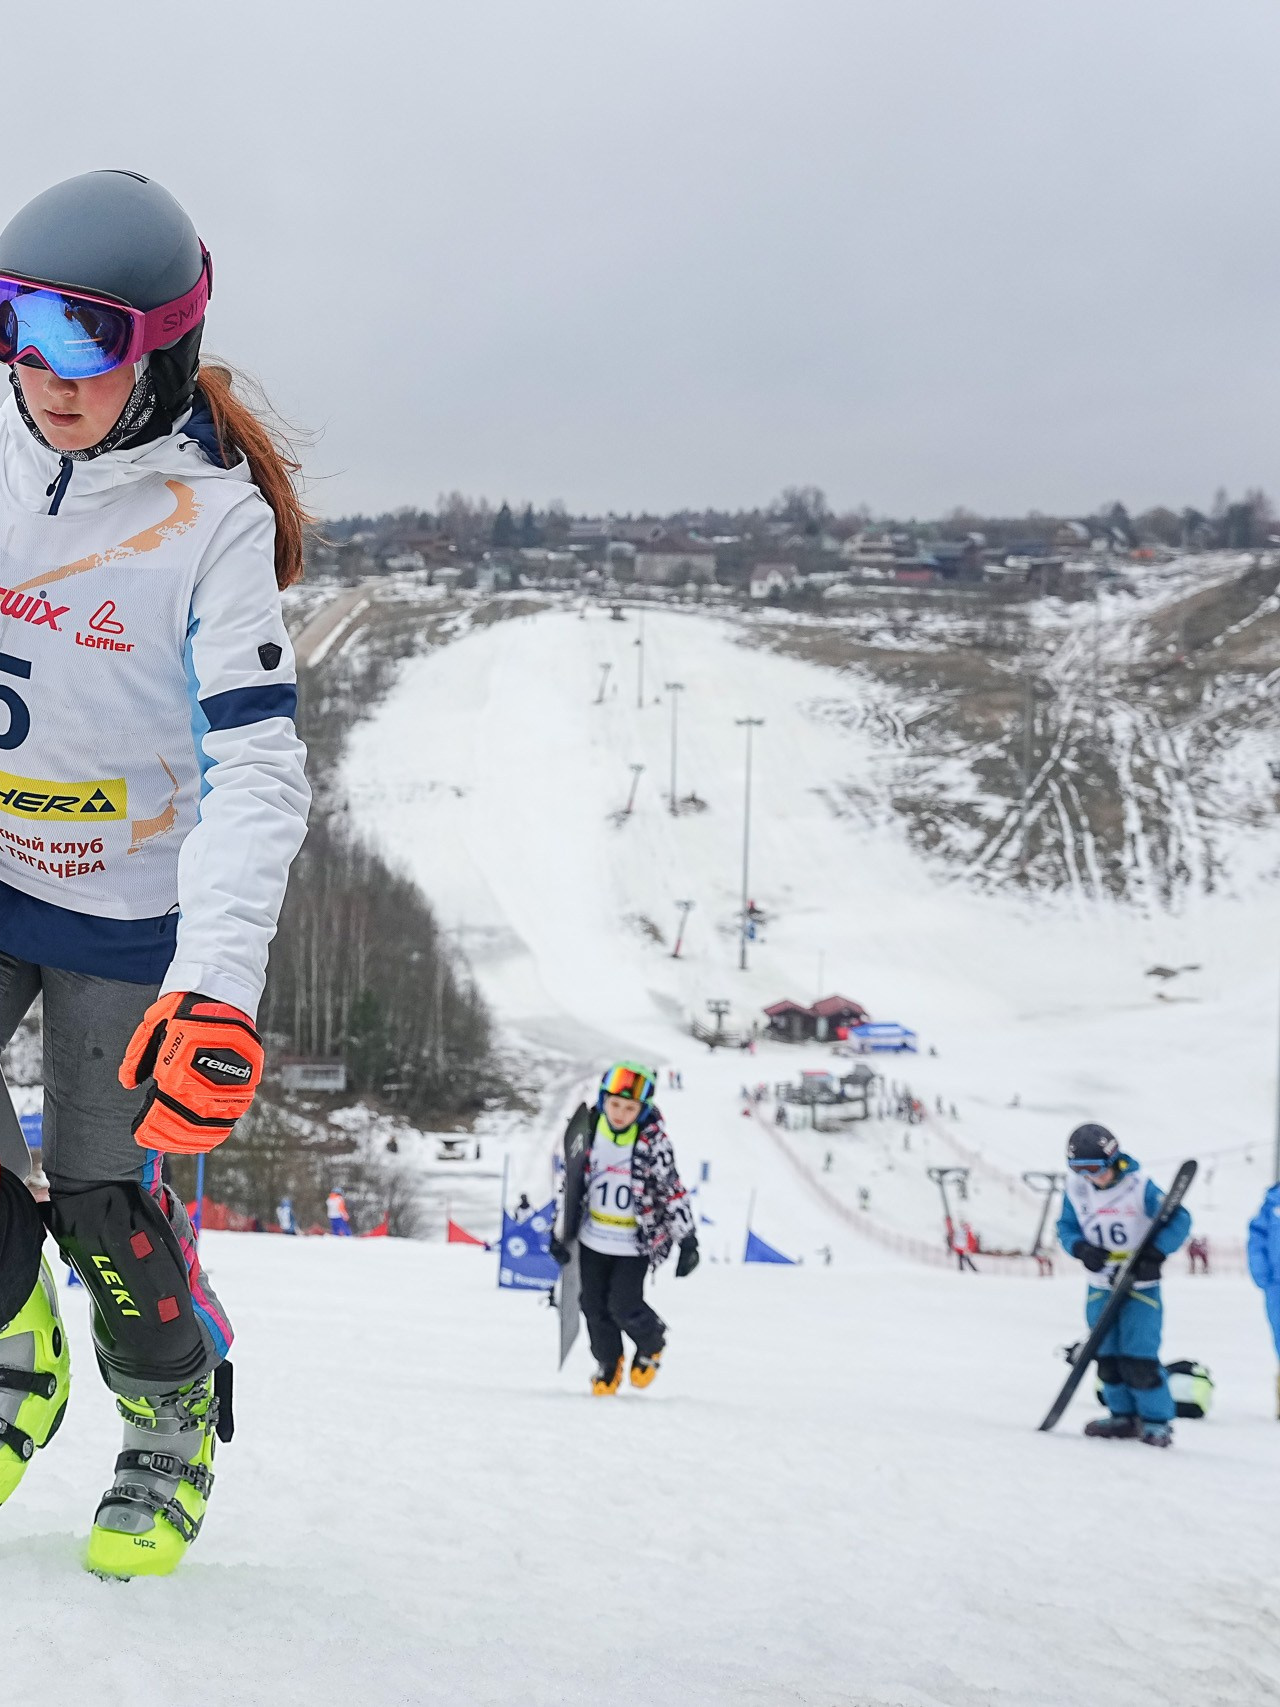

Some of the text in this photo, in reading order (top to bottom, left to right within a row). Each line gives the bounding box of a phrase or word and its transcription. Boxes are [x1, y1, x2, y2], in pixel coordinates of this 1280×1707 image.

[6, 845, 106, 878] ТЯГАЧЁВА
[50, 837, 104, 858] клуб
[163, 1031, 185, 1066] racing
[197, 1056, 252, 1080] reusch
[596, 1181, 631, 1210] 10
[1092, 1221, 1128, 1248] 16
[91, 1255, 141, 1317] LEKI
